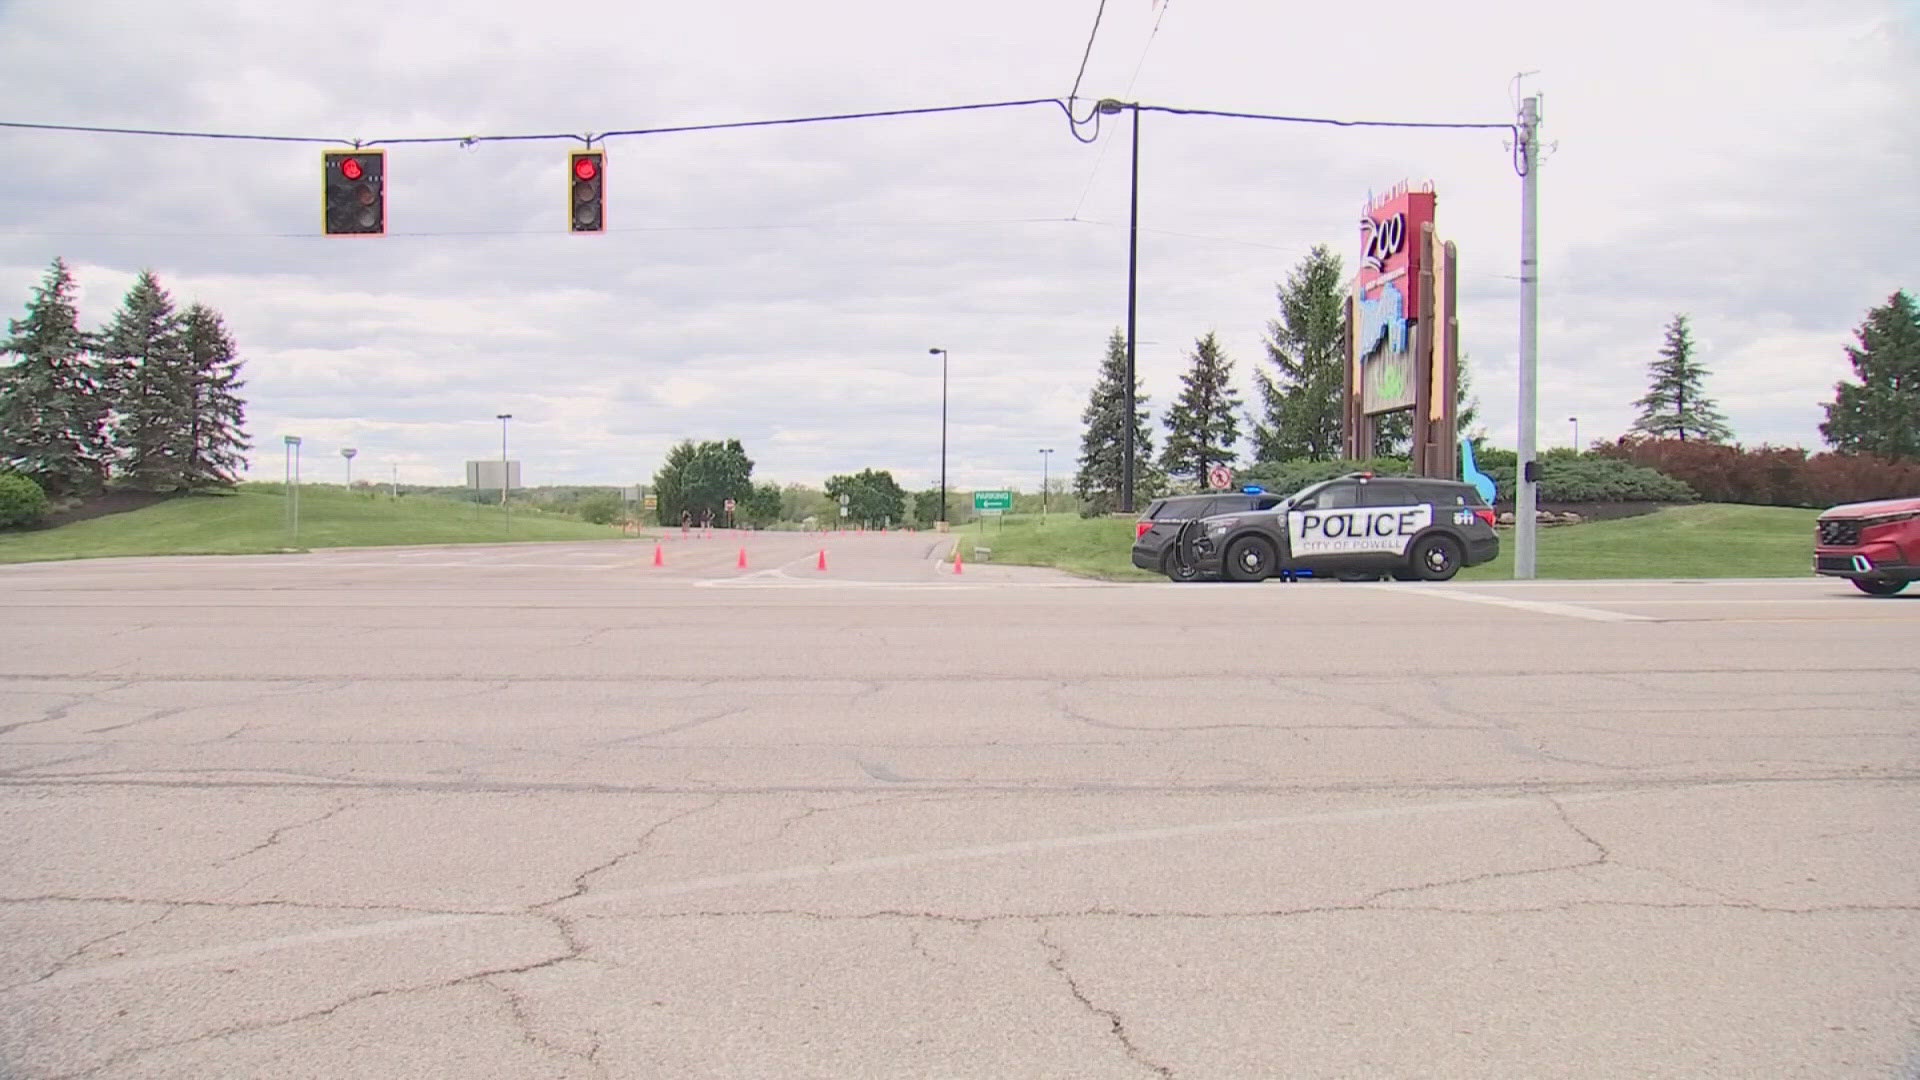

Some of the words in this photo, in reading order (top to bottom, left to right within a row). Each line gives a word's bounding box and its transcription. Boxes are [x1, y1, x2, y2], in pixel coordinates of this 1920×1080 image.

[1360, 212, 1404, 272] ZOO
[1301, 512, 1416, 538] POLICE
[1304, 541, 1330, 550] CITY
[1334, 540, 1349, 550] OF
[1353, 539, 1401, 549] POWELL
